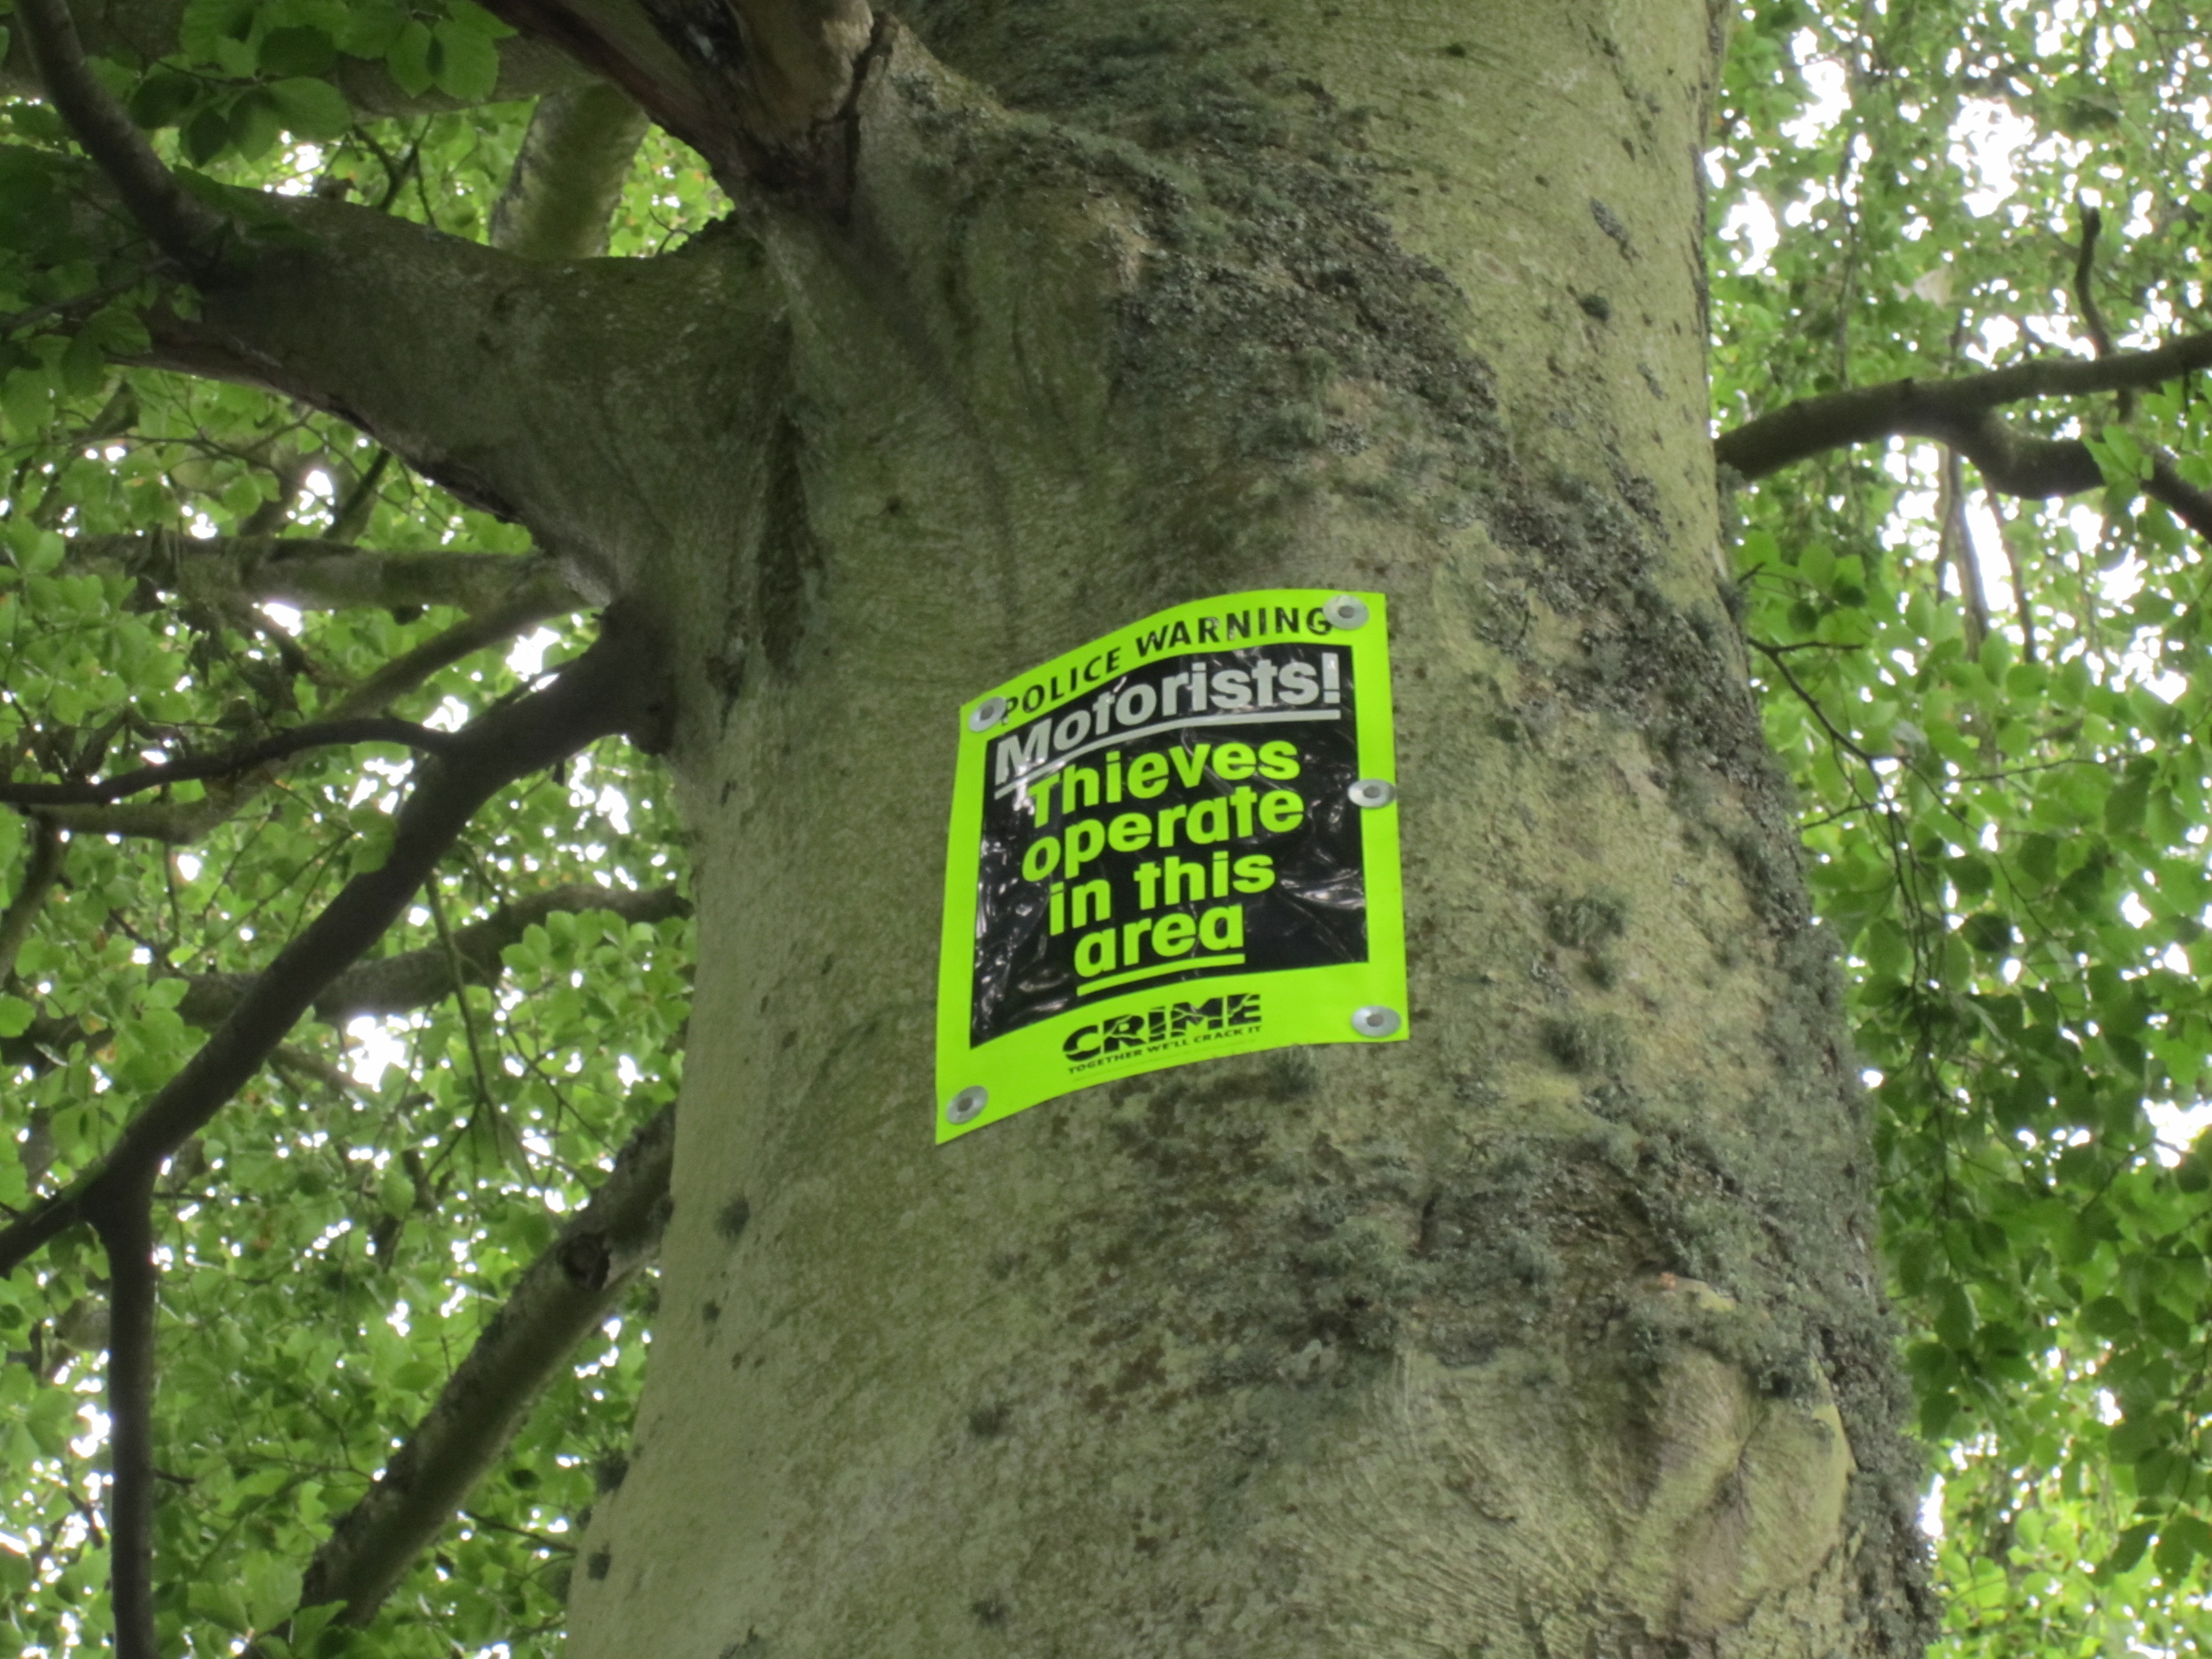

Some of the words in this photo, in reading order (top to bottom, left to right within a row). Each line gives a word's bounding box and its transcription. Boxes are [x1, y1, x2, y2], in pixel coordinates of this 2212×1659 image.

[1001, 646, 1121, 726] POLICE
[1135, 606, 1332, 657] WARNING
[994, 653, 1341, 785] Motorists!
[1028, 740, 1301, 828] Thieves
[1022, 785, 1304, 883] operate
[1049, 877, 1111, 935] in
[1133, 850, 1275, 910] this
[1074, 905, 1245, 977] area
[1062, 993, 1262, 1062] CRIME
[1068, 1050, 1143, 1074] TOGETHER
[1146, 1039, 1189, 1053] WE'LL
[1194, 1029, 1242, 1044] CRACK
[1248, 1025, 1262, 1034] IT
